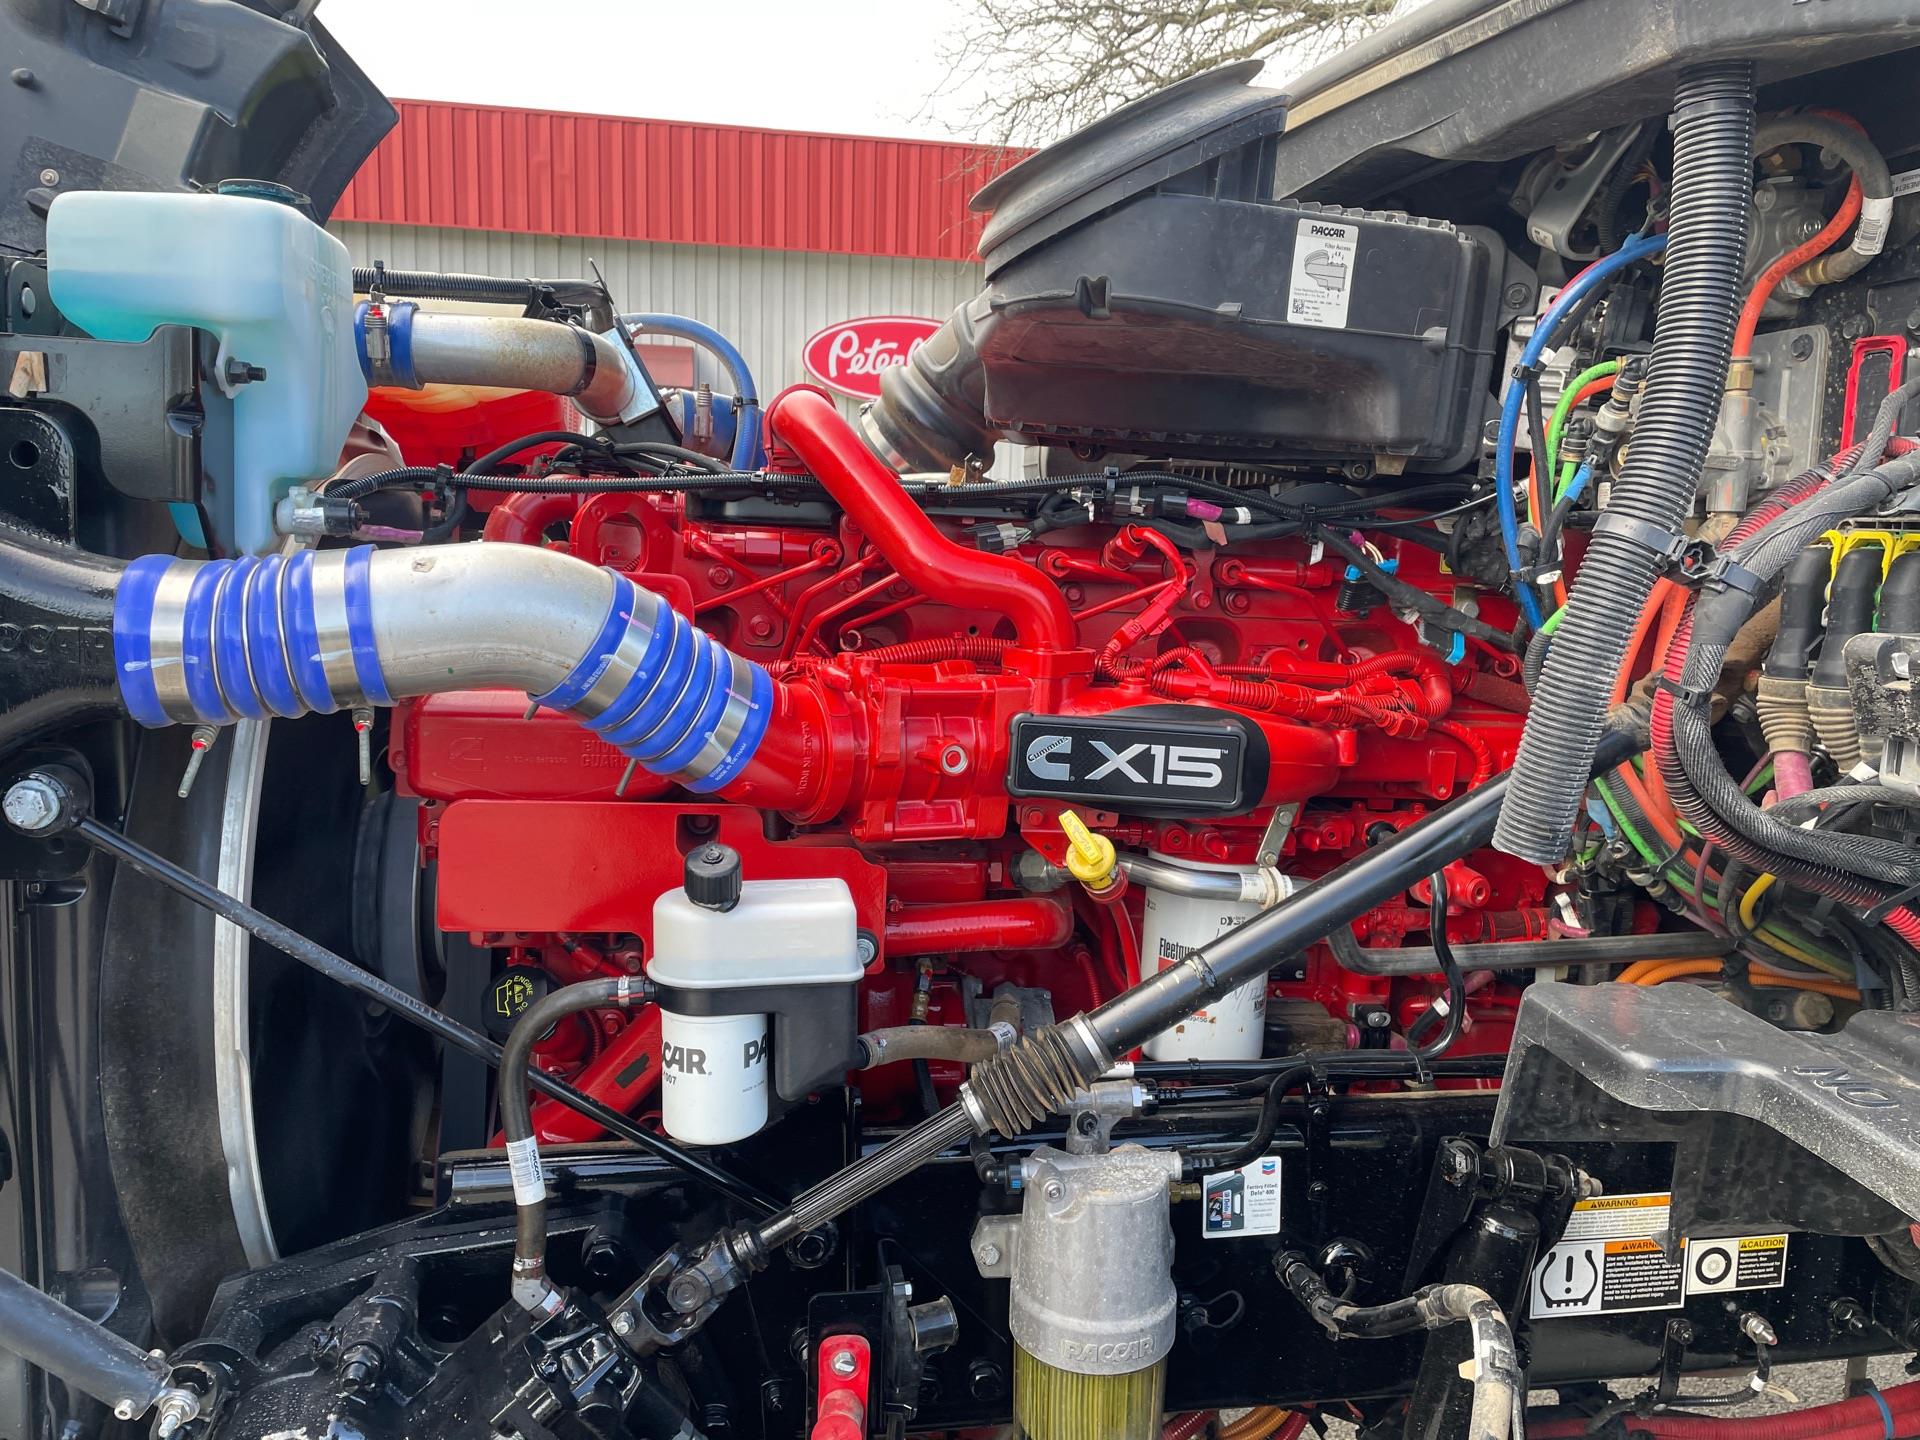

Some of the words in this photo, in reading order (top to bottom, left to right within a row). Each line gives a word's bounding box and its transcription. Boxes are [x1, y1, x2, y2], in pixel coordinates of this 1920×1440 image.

[1311, 225, 1346, 238] PACCAR
[828, 330, 922, 378] Peter
[1027, 735, 1069, 762] Cummins
[1084, 740, 1222, 788] X15
[514, 976, 533, 996] ENGINE
[516, 1001, 528, 1012] OIL
[1597, 1199, 1638, 1208] WARNING
[1629, 1241, 1656, 1249] WARN
[1747, 1239, 1784, 1248] CAUTION
[1062, 1337, 1153, 1362] PACCAR
